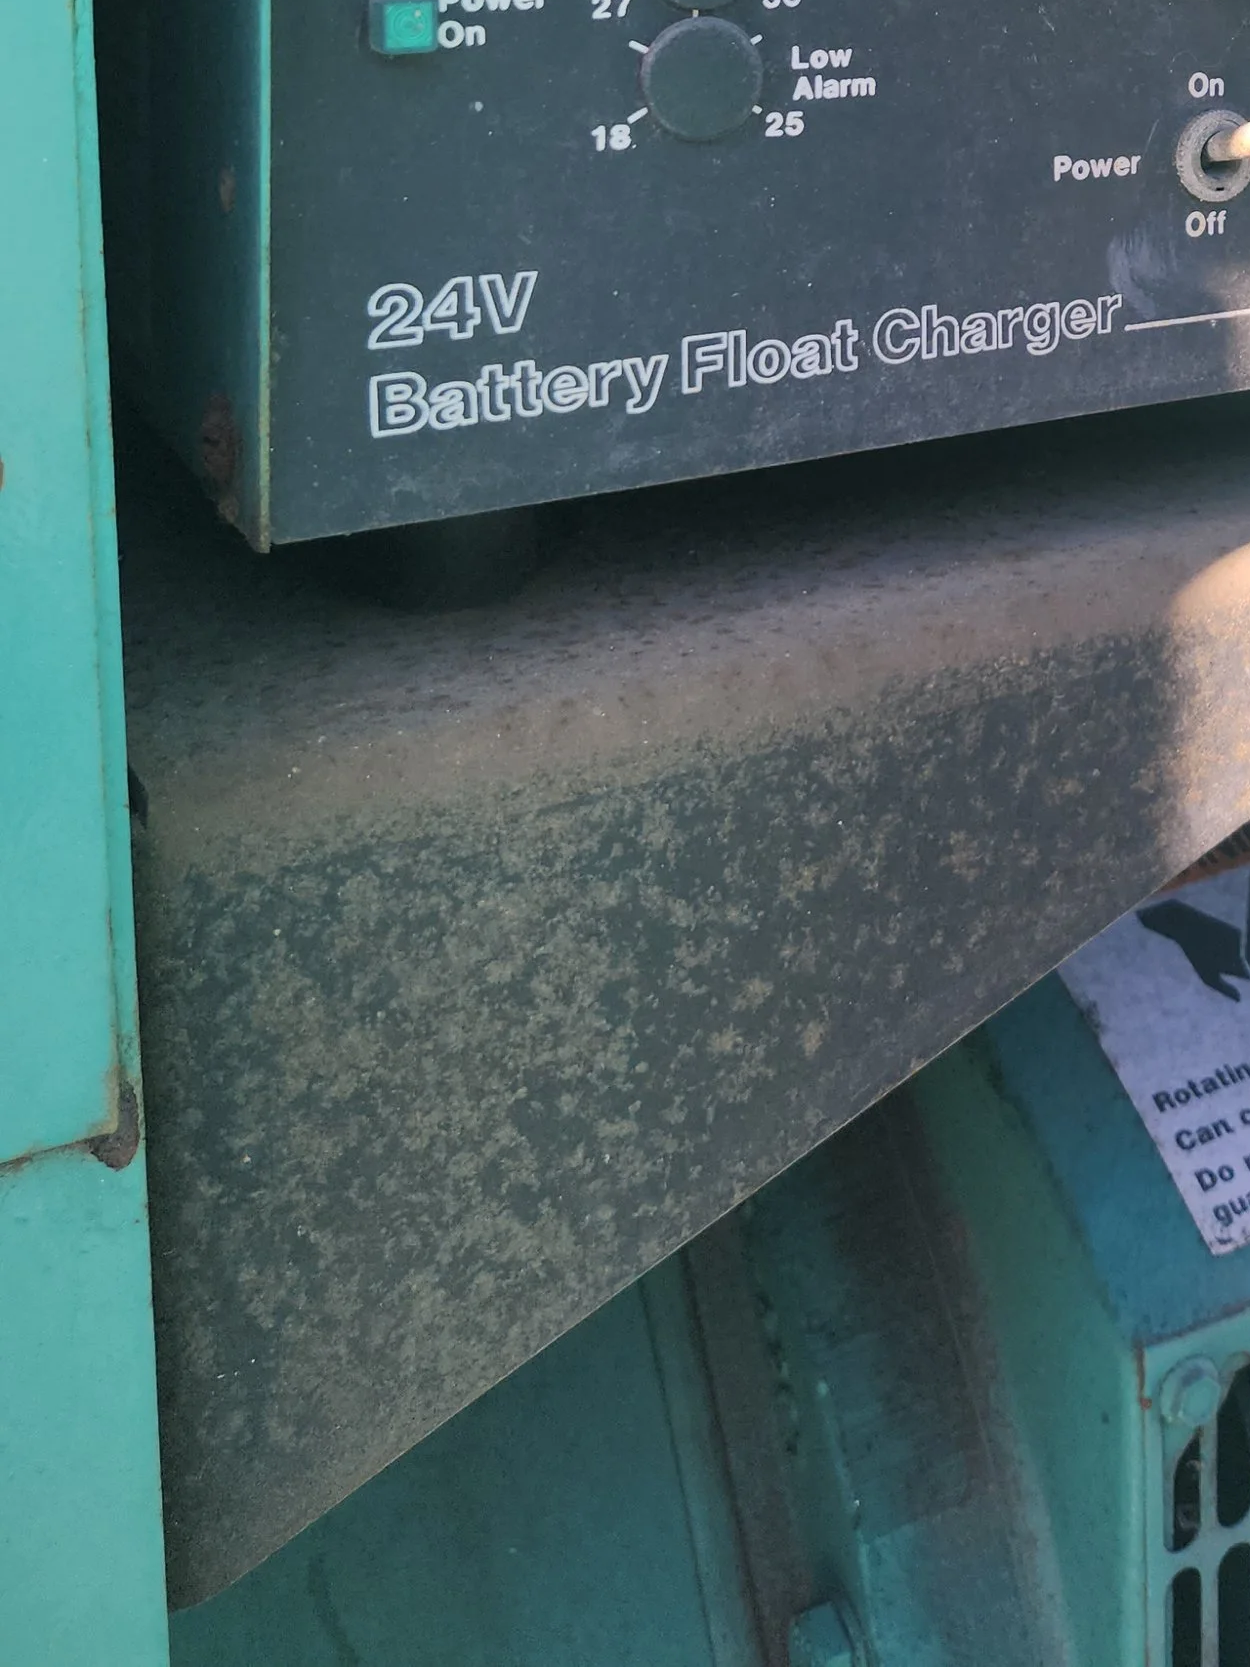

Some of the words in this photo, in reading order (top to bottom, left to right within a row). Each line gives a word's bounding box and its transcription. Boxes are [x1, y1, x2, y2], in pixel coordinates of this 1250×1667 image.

[438, 21, 486, 49] On
[791, 46, 852, 69] Low
[792, 75, 876, 101] Alarm
[1188, 72, 1225, 98] On
[591, 124, 632, 152] 18
[765, 111, 804, 137] 25
[1053, 154, 1141, 181] Power
[1185, 210, 1227, 238] Off
[367, 270, 538, 351] 24V
[370, 353, 668, 438] Battery
[682, 319, 858, 395] Float
[873, 291, 1122, 365] Charger
[1175, 1118, 1235, 1151] Can
[1194, 1164, 1235, 1193] Do
